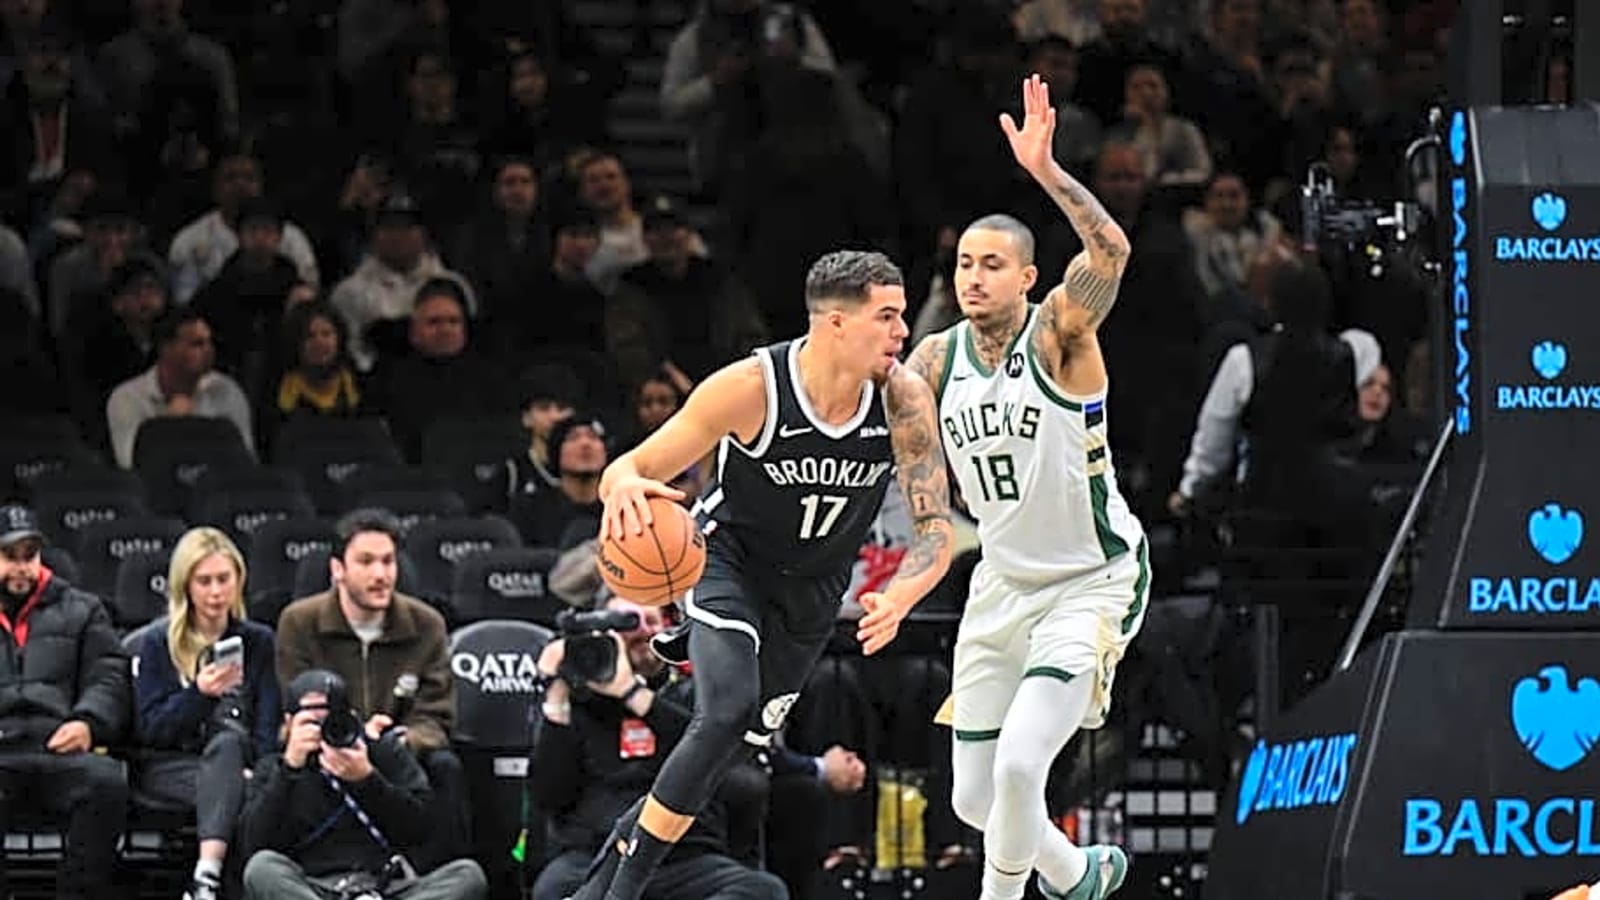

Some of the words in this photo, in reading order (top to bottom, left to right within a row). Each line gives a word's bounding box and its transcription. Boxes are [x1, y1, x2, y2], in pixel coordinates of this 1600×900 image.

[1496, 238, 1600, 260] BARCLAYS
[1453, 178, 1470, 434] BARCLAYS
[1498, 386, 1600, 409] BARCLAYS
[944, 402, 1041, 449] BUCKS
[971, 454, 1020, 502] 18
[800, 493, 849, 540] 17
[451, 652, 538, 683] QATA
[481, 676, 545, 693] AIRW
[1255, 733, 1357, 812] BARCLAYS
